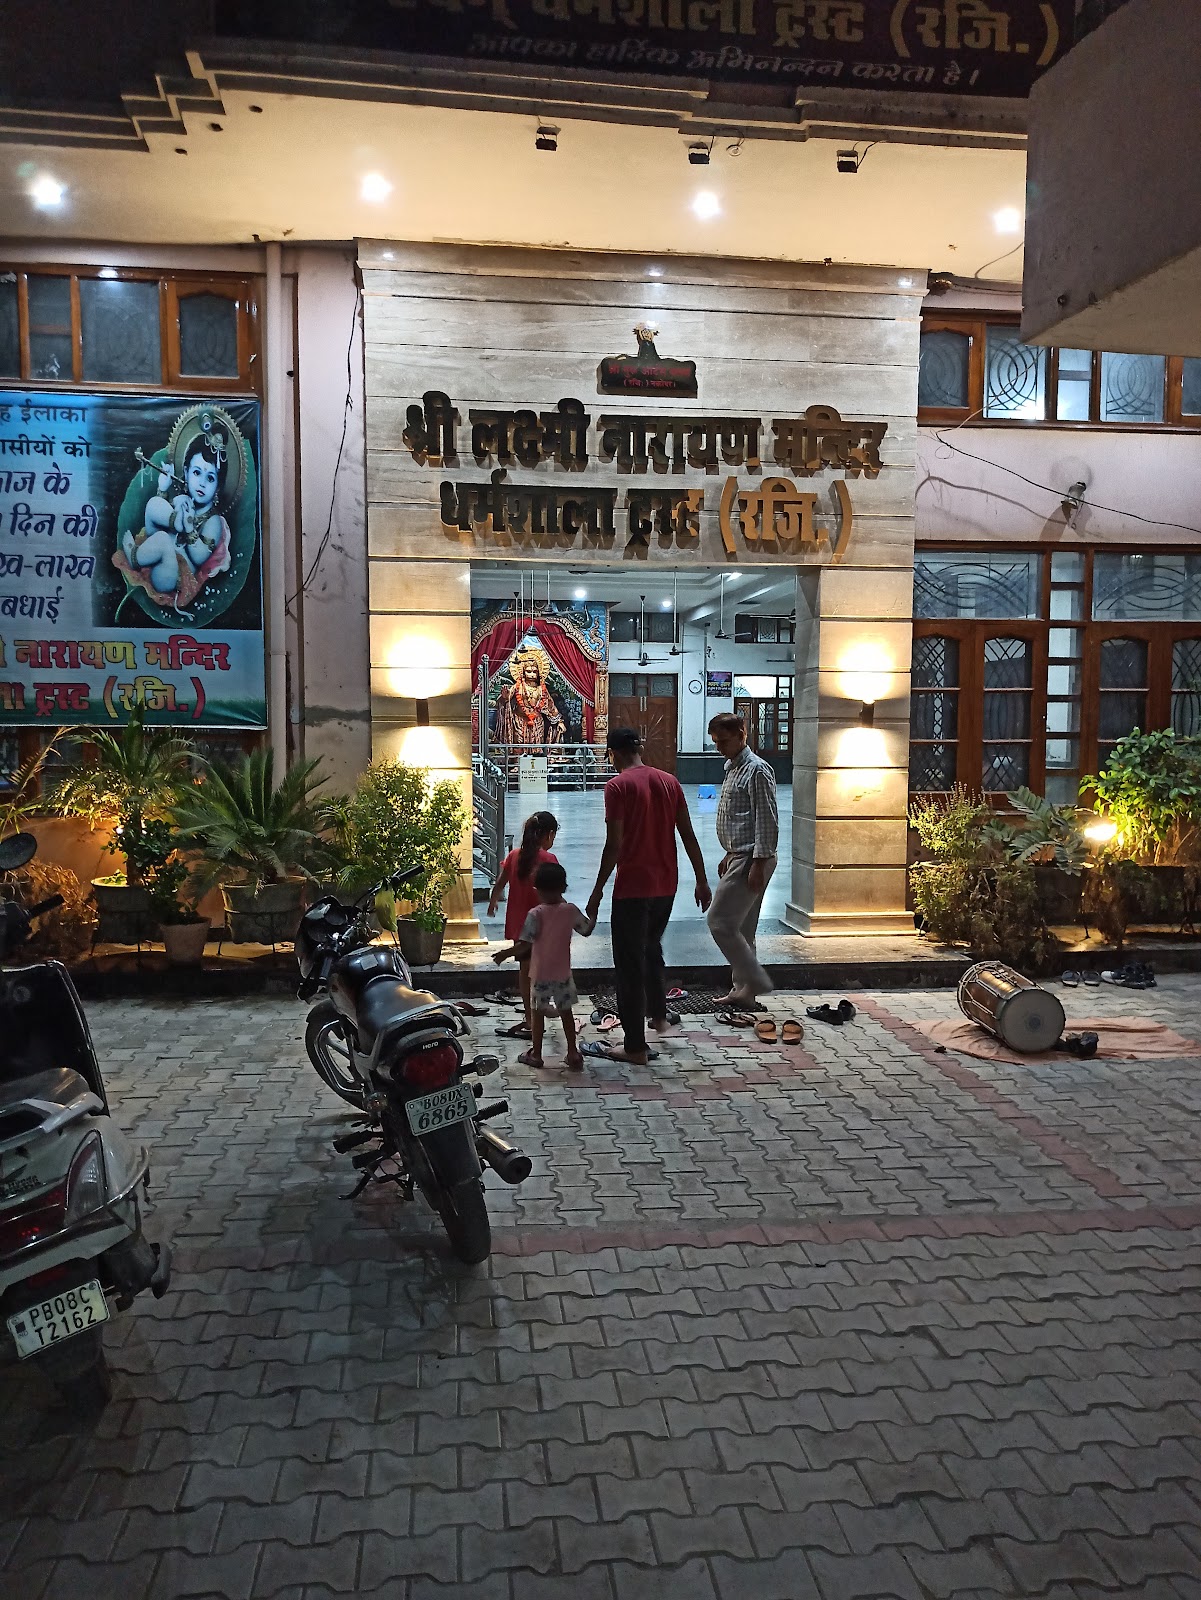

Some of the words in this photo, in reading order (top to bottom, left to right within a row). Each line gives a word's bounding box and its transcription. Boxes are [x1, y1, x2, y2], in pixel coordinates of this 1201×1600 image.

[772, 0, 864, 49] ट्रस्ट
[890, 0, 1060, 66] (रजि.)
[851, 62, 935, 82] करता
[18, 398, 89, 425] ईलाका
[61, 435, 92, 458] को
[403, 391, 459, 459] श्री
[468, 398, 591, 462] लक्ष्मी
[600, 414, 761, 464] नारायण
[771, 405, 888, 470] मन्दिर
[0, 471, 36, 495] ाज
[43, 462, 73, 495] के
[10, 502, 56, 537] दिन
[62, 504, 98, 538] की
[440, 468, 619, 536] धर्मशाला
[626, 487, 703, 548] ट्रस्ट
[720, 476, 852, 554] (रजि.)
[0, 586, 65, 624] बधाई
[14, 639, 137, 670] नारायण
[144, 634, 232, 671] मन्दिर
[33, 682, 92, 717] ट्रस्ट
[103, 675, 207, 720] (रजि.)
[418, 1099, 468, 1130] 6865
[29, 1287, 91, 1327] PB08C
[35, 1306, 97, 1346] T2162
